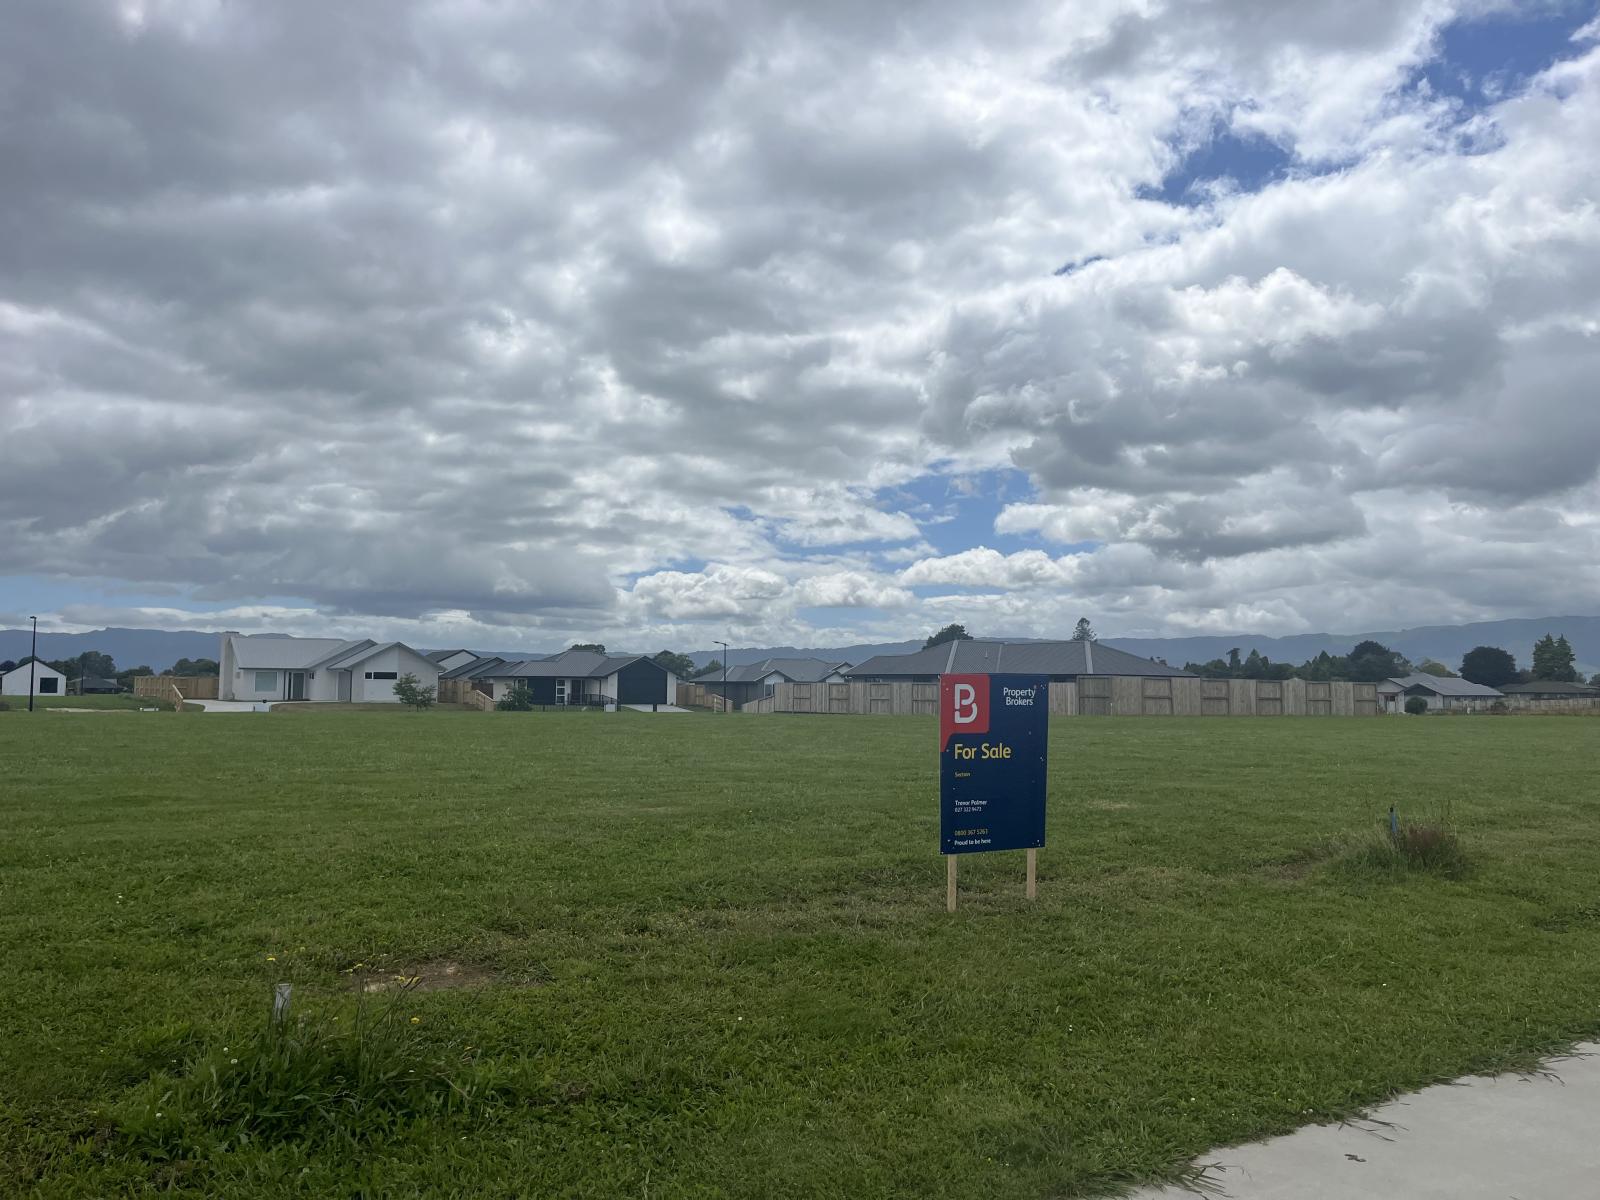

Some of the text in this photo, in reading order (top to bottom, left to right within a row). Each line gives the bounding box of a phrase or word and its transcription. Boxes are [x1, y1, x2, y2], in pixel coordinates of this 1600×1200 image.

[1003, 687, 1036, 698] Property
[1006, 697, 1034, 706] Brokers
[954, 742, 1012, 760] For Sale
